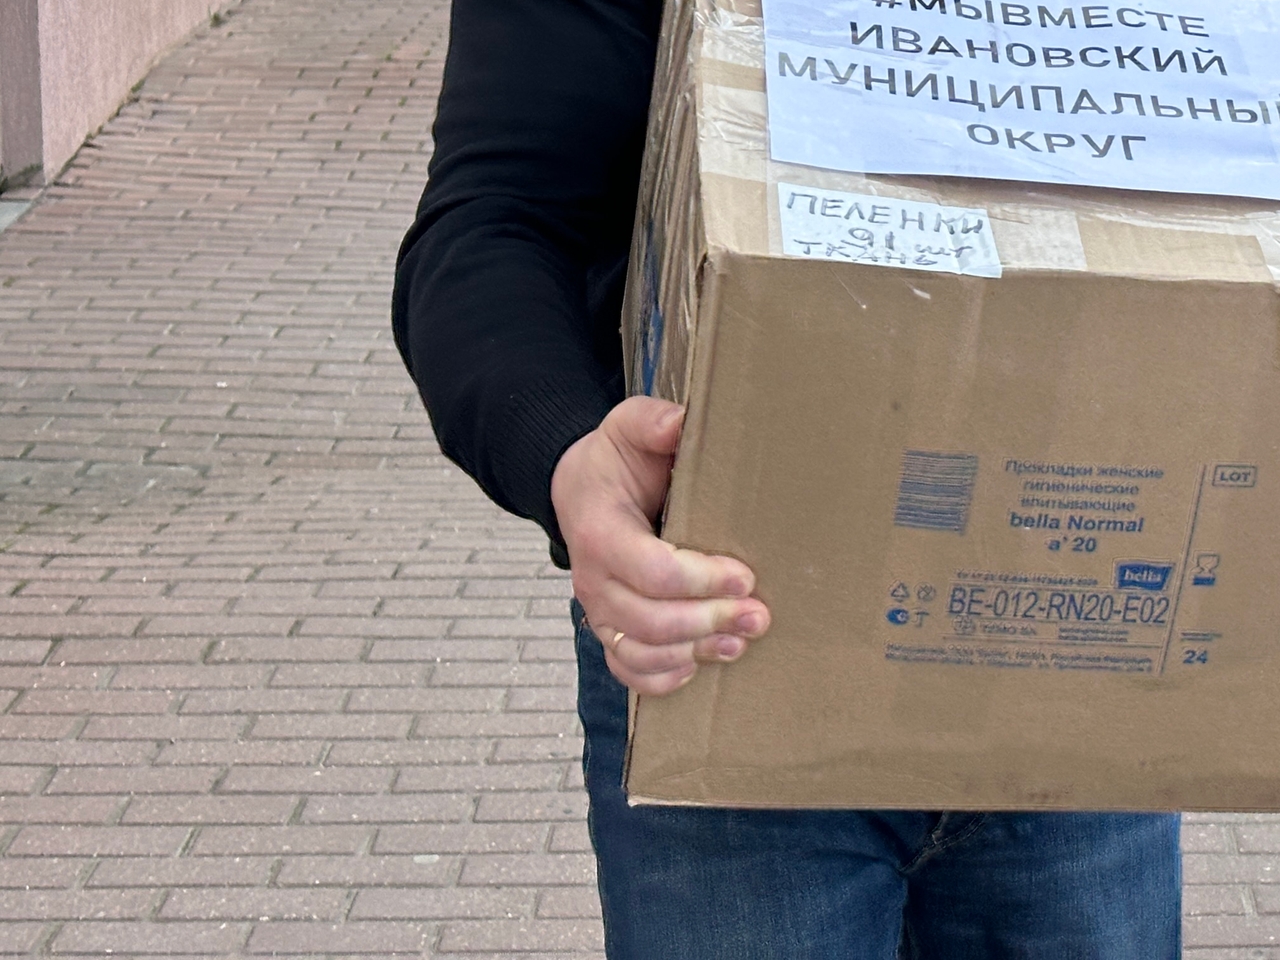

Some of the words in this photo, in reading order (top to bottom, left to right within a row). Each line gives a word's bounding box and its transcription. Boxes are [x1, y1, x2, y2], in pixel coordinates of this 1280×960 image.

[849, 21, 1228, 76] ИВАНОВСКИЙ
[966, 124, 1147, 161] ОКРУГ
[786, 192, 984, 234] ПЕЛЕНКИ
[1005, 459, 1093, 478] Прокладки
[1096, 466, 1164, 479] женские
[1220, 472, 1251, 482] LOT
[1020, 497, 1136, 512] впитывающие
[1010, 512, 1060, 529] bella
[1067, 515, 1145, 533] Normal
[1072, 537, 1097, 552] 20
[1124, 568, 1163, 582] bella
[949, 586, 1170, 624] BE-012-RN20-E02
[1183, 650, 1208, 664] 24
